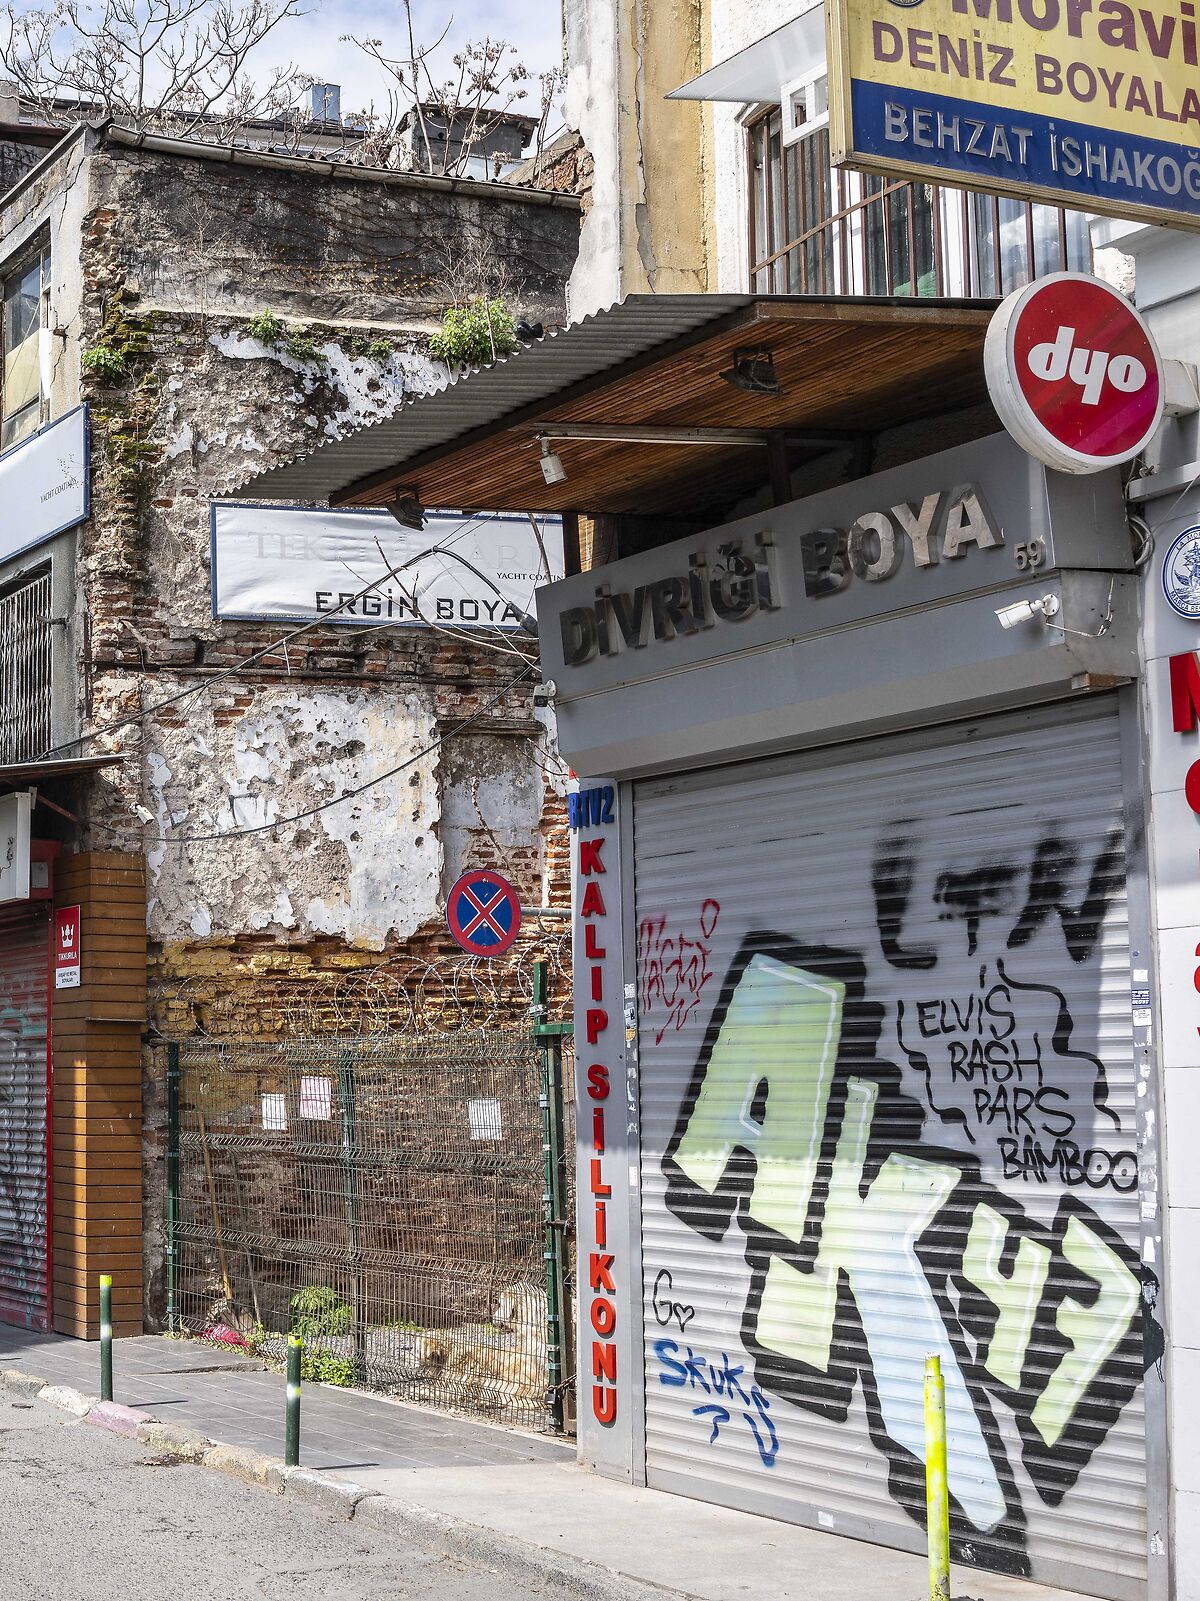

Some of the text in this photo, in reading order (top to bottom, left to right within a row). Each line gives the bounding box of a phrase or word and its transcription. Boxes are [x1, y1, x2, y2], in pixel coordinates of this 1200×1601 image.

[872, 20, 1017, 88] DENİZ
[884, 101, 1034, 166] BEHZAT
[1028, 326, 1147, 405] dyo
[800, 482, 1005, 600] BOYA
[1013, 536, 1046, 571] 59
[496, 571, 527, 580] YACHT
[315, 588, 522, 623] ERGİN BOYA
[579, 838, 608, 1047] KALIP
[947, 1033, 1043, 1087] RASH
[973, 1083, 1076, 1137] PARS
[997, 1134, 1138, 1191] BAMBOO
